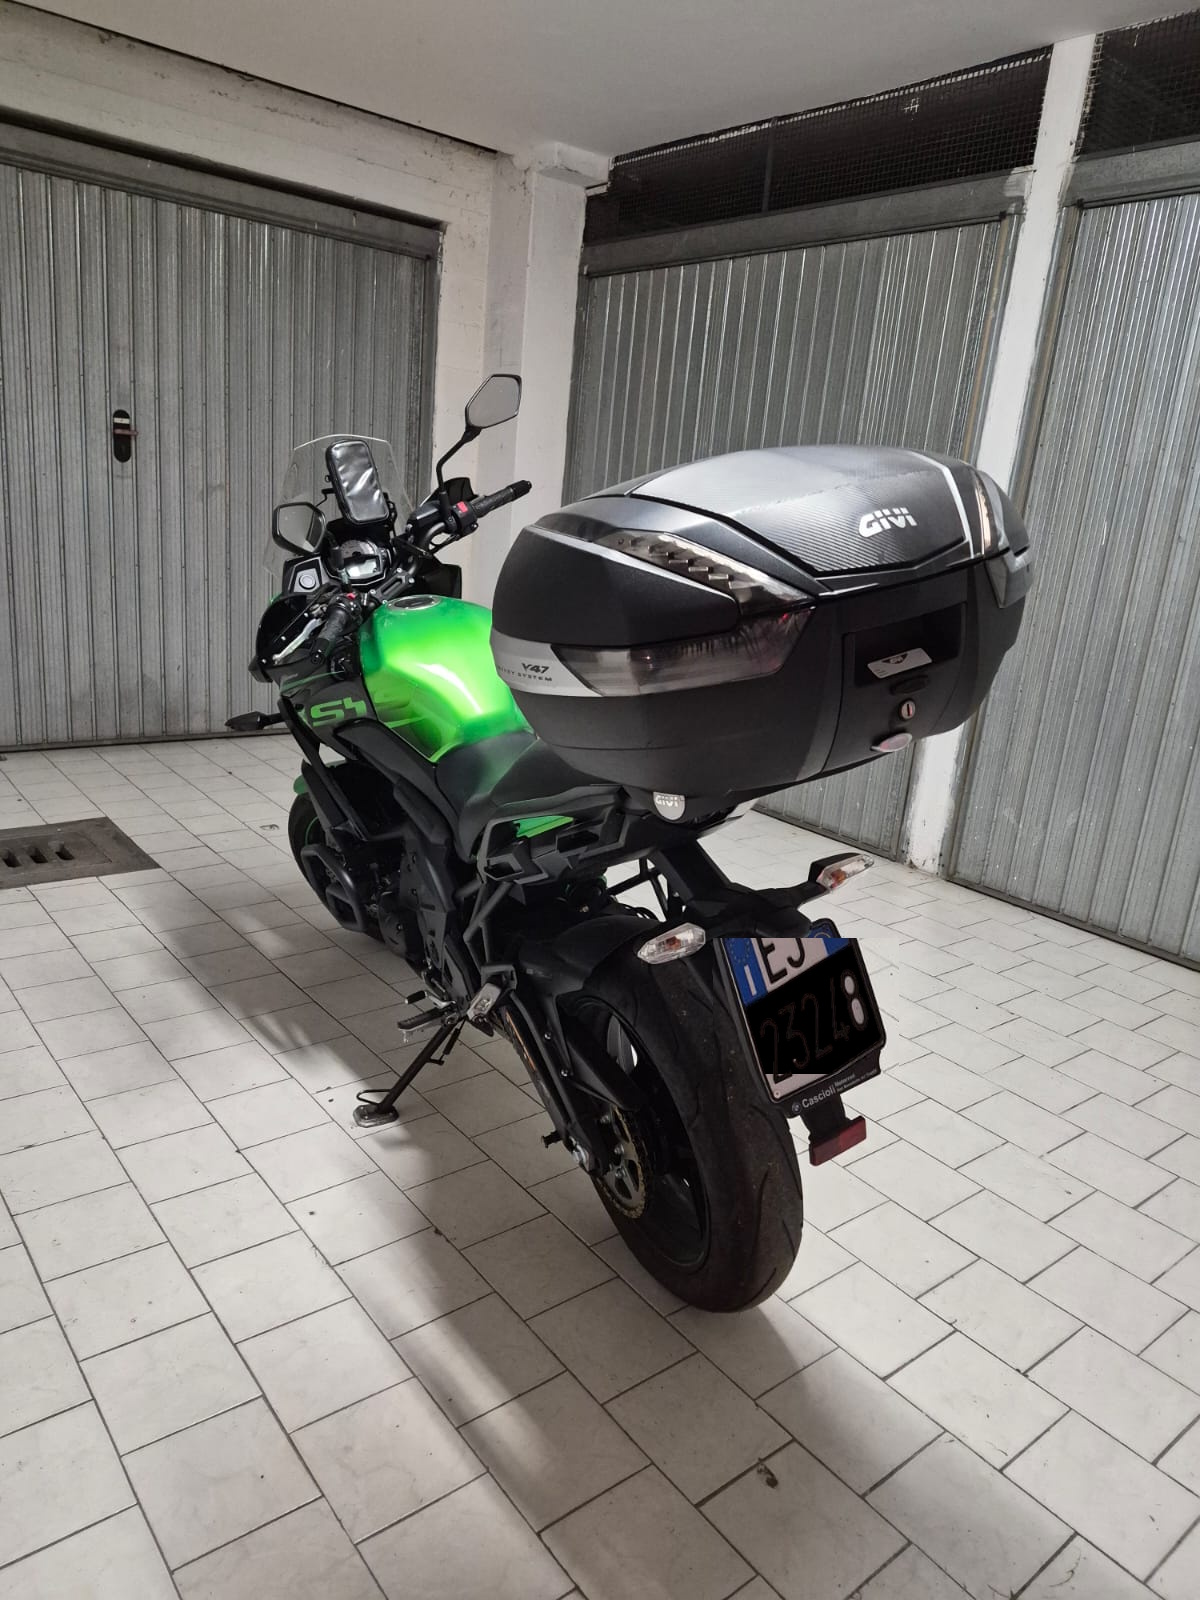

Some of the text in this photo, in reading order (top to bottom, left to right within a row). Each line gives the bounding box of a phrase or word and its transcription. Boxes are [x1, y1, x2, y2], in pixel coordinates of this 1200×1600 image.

[859, 507, 917, 537] GIVI
[521, 662, 550, 674] V47
[517, 672, 552, 681] SYSTEM
[655, 794, 679, 807] GIVI
[801, 1084, 837, 1109] Cascioli
